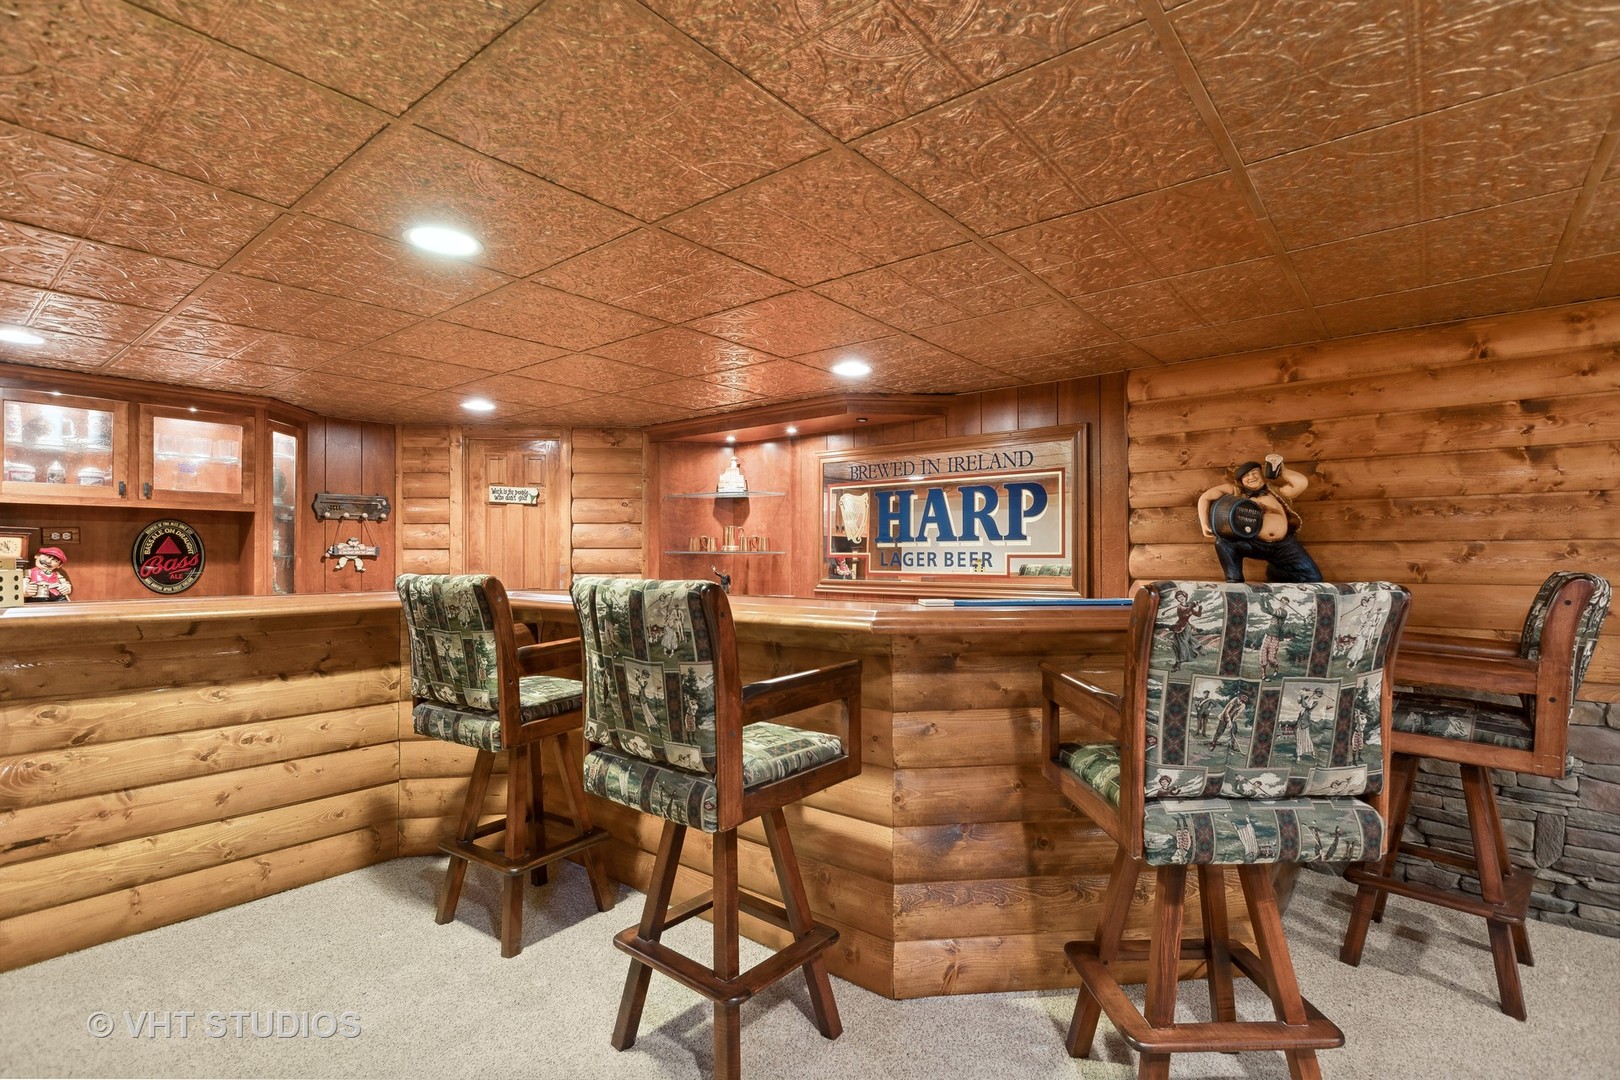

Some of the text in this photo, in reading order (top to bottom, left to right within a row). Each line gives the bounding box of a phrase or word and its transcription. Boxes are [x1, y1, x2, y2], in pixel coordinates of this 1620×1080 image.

[850, 450, 1034, 481] BREWED IN IRELAND
[874, 482, 1049, 547] HARP
[144, 538, 154, 554] BASS
[153, 530, 164, 540] ALE
[176, 530, 194, 554] DRAUGHT
[140, 553, 200, 577] Bass
[880, 551, 993, 567] LAGER BEER
